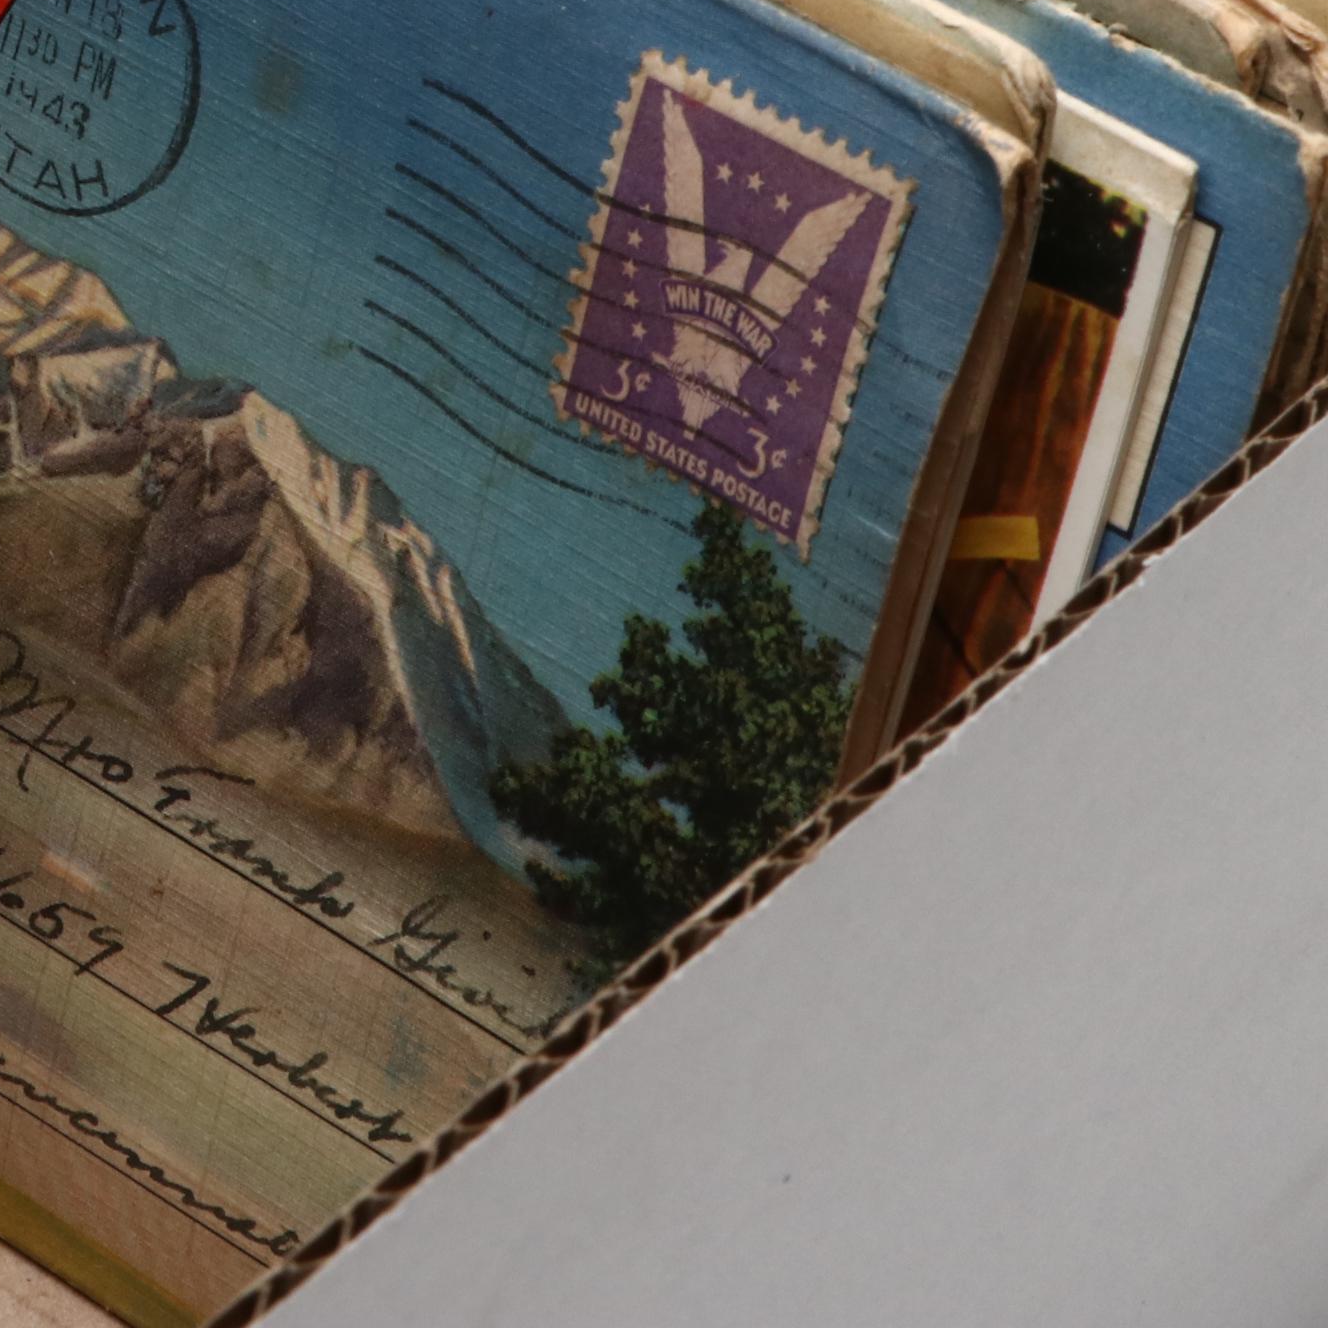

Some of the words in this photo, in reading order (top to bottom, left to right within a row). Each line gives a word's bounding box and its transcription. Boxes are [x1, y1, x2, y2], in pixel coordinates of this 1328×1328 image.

[74, 41, 118, 101] PM
[665, 283, 701, 312] WIN
[704, 290, 738, 327] THE
[735, 312, 774, 359] WAR
[574, 392, 642, 443] UNITED
[646, 429, 709, 481] STATES
[709, 467, 793, 529] POSTAGE
